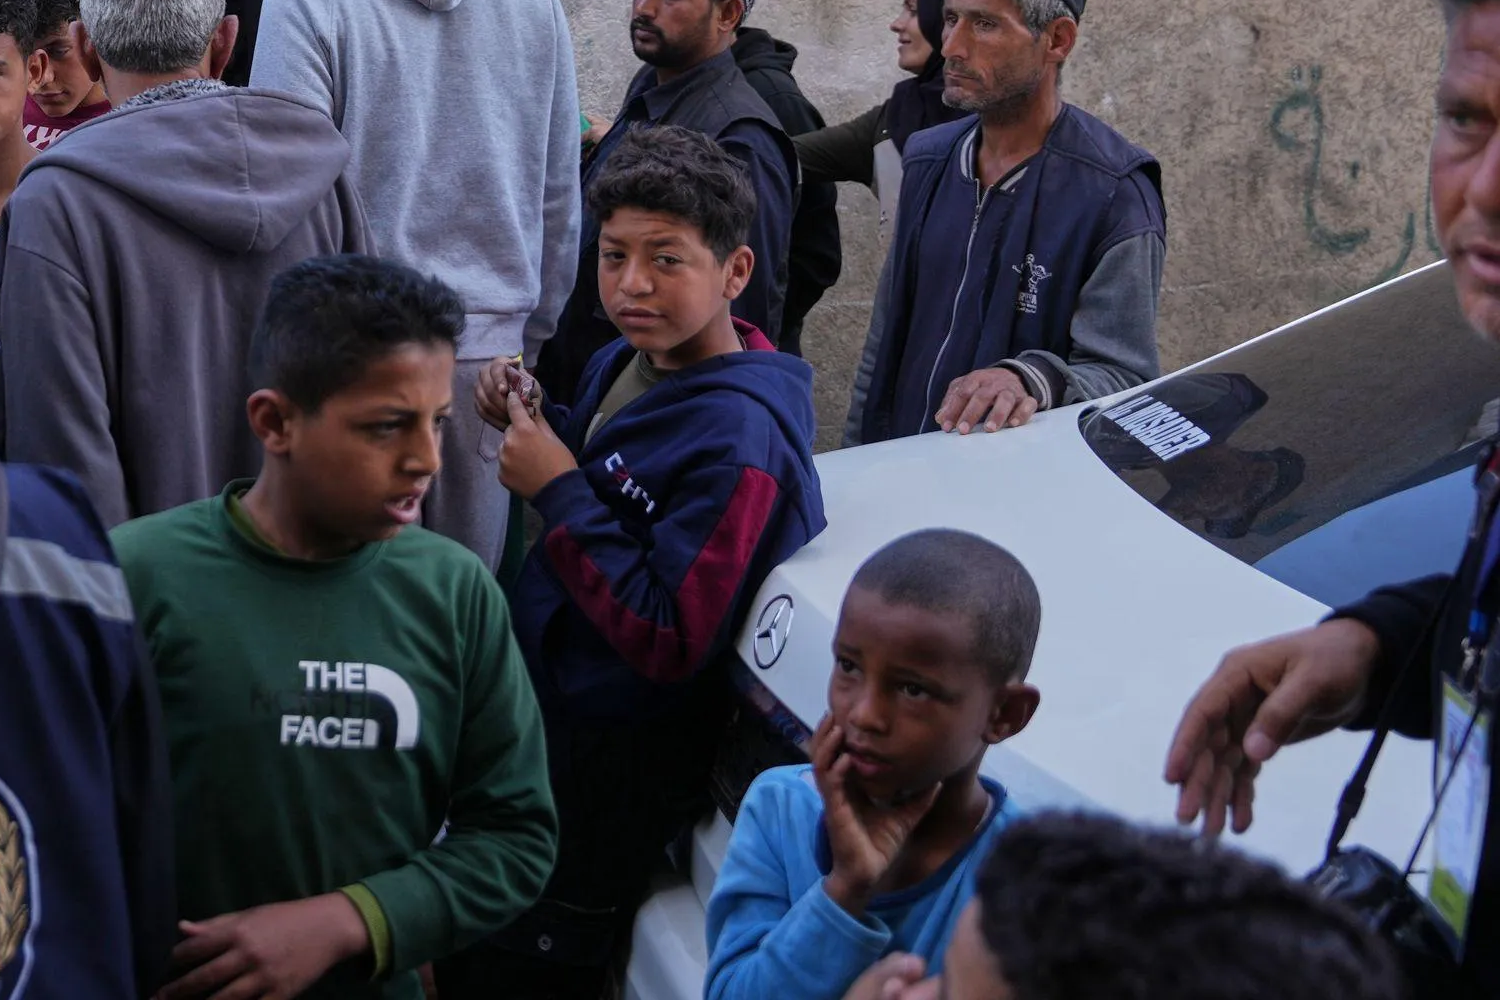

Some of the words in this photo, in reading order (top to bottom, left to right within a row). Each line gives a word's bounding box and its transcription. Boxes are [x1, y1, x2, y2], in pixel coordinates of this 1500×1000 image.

[1113, 400, 1211, 462] MOSADER
[298, 659, 365, 693] THE
[280, 713, 364, 749] FACE
